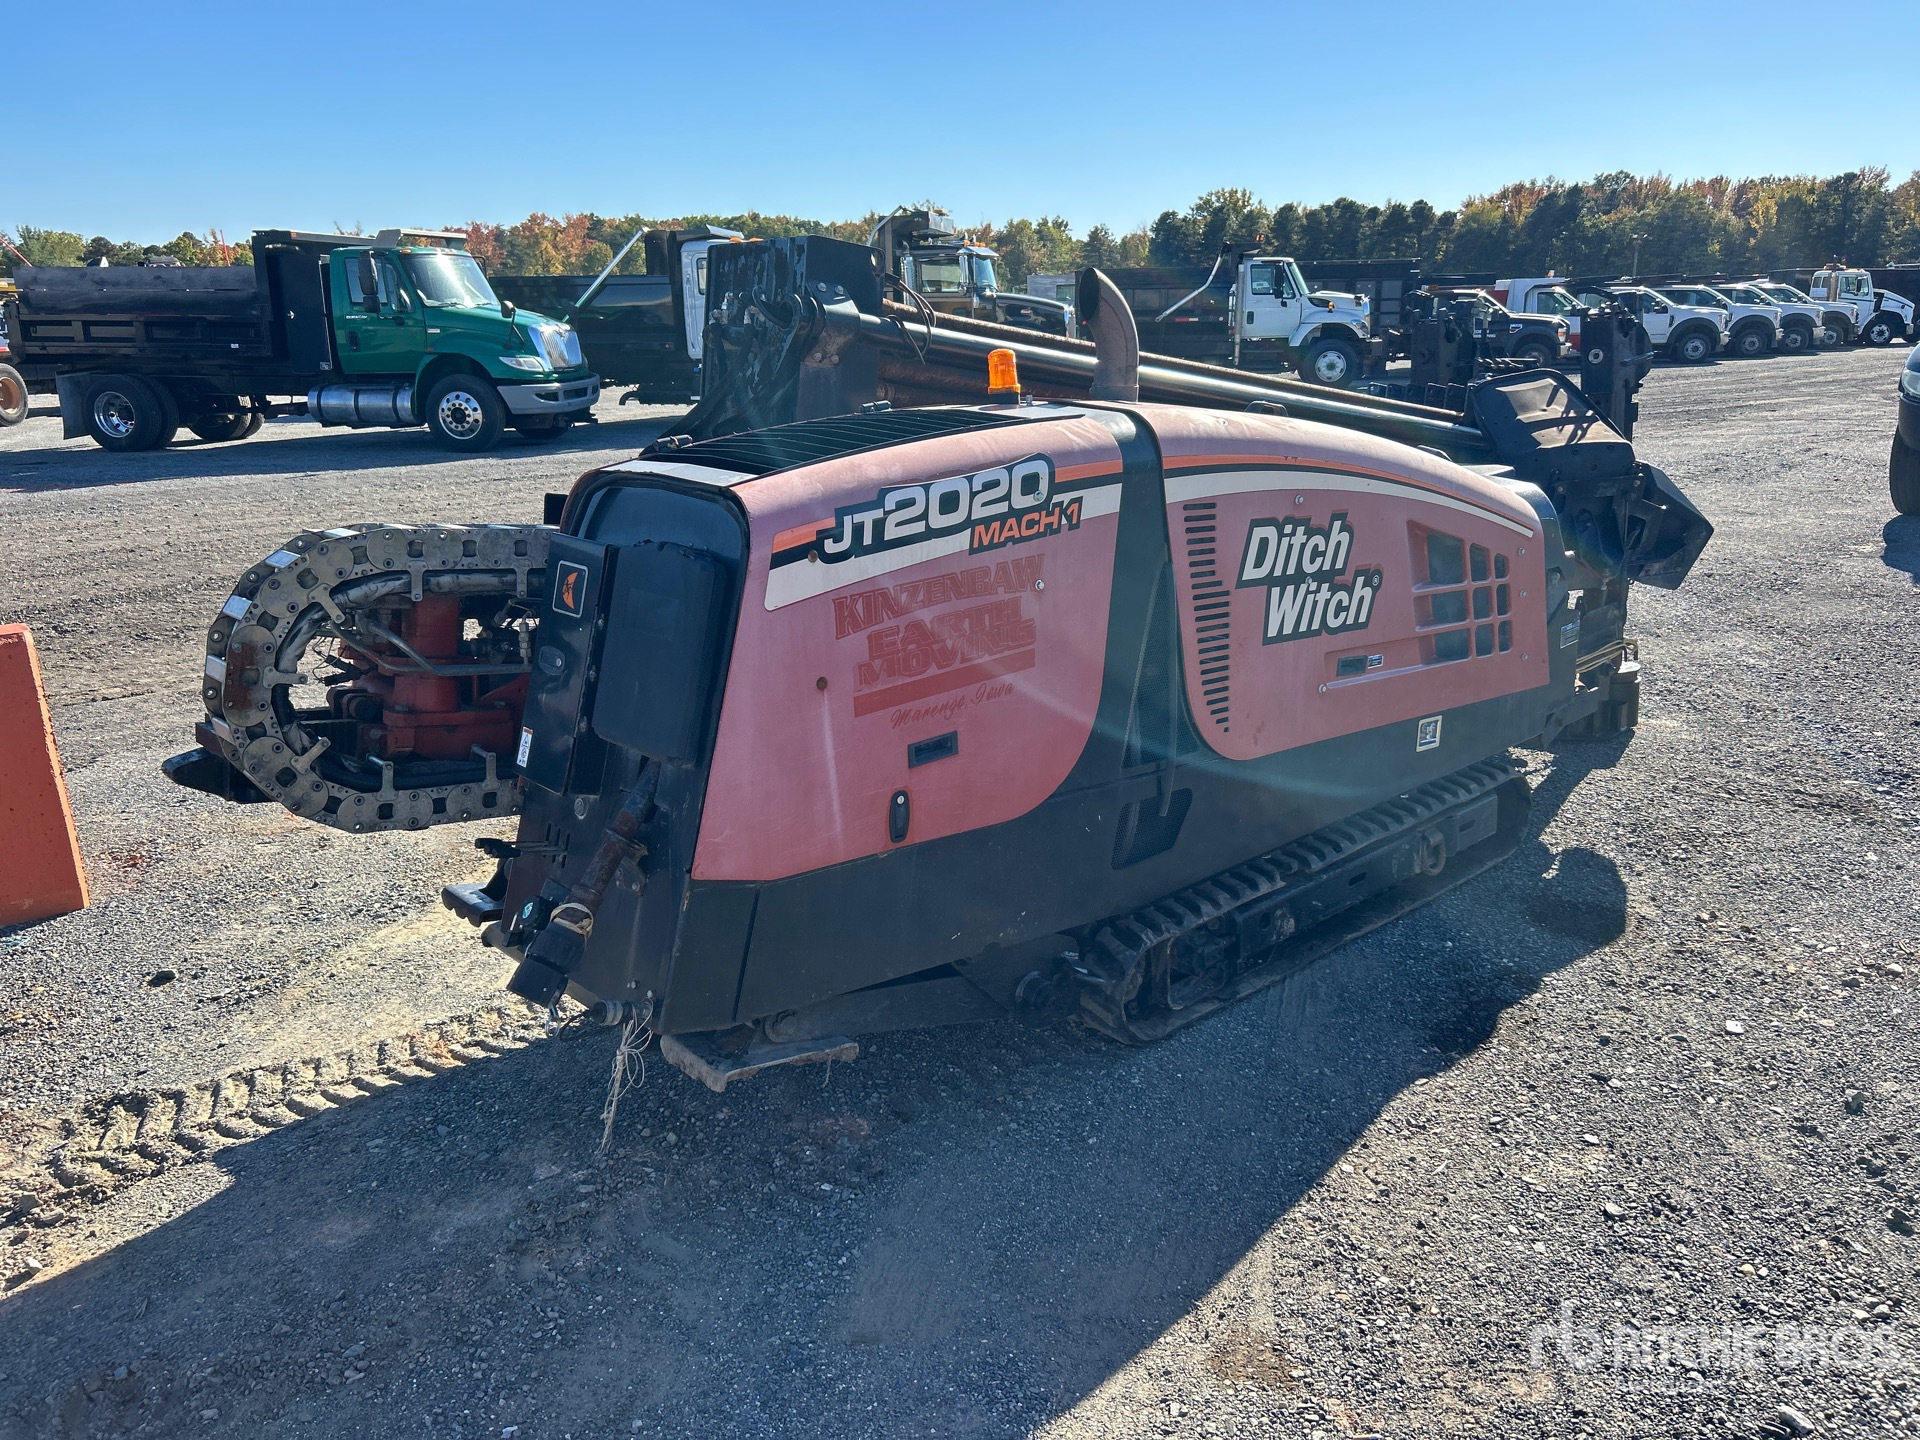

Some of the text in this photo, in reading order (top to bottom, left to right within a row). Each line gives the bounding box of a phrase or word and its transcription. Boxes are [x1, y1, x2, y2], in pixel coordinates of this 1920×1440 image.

[823, 460, 1049, 554] JT2020
[973, 508, 1060, 548] MACH
[1242, 520, 1350, 581] Ditch
[832, 554, 1045, 640] KINZENBAW
[866, 596, 1023, 662] EARTH
[857, 618, 1037, 690] MOVING
[969, 682, 1015, 706] Iowa
